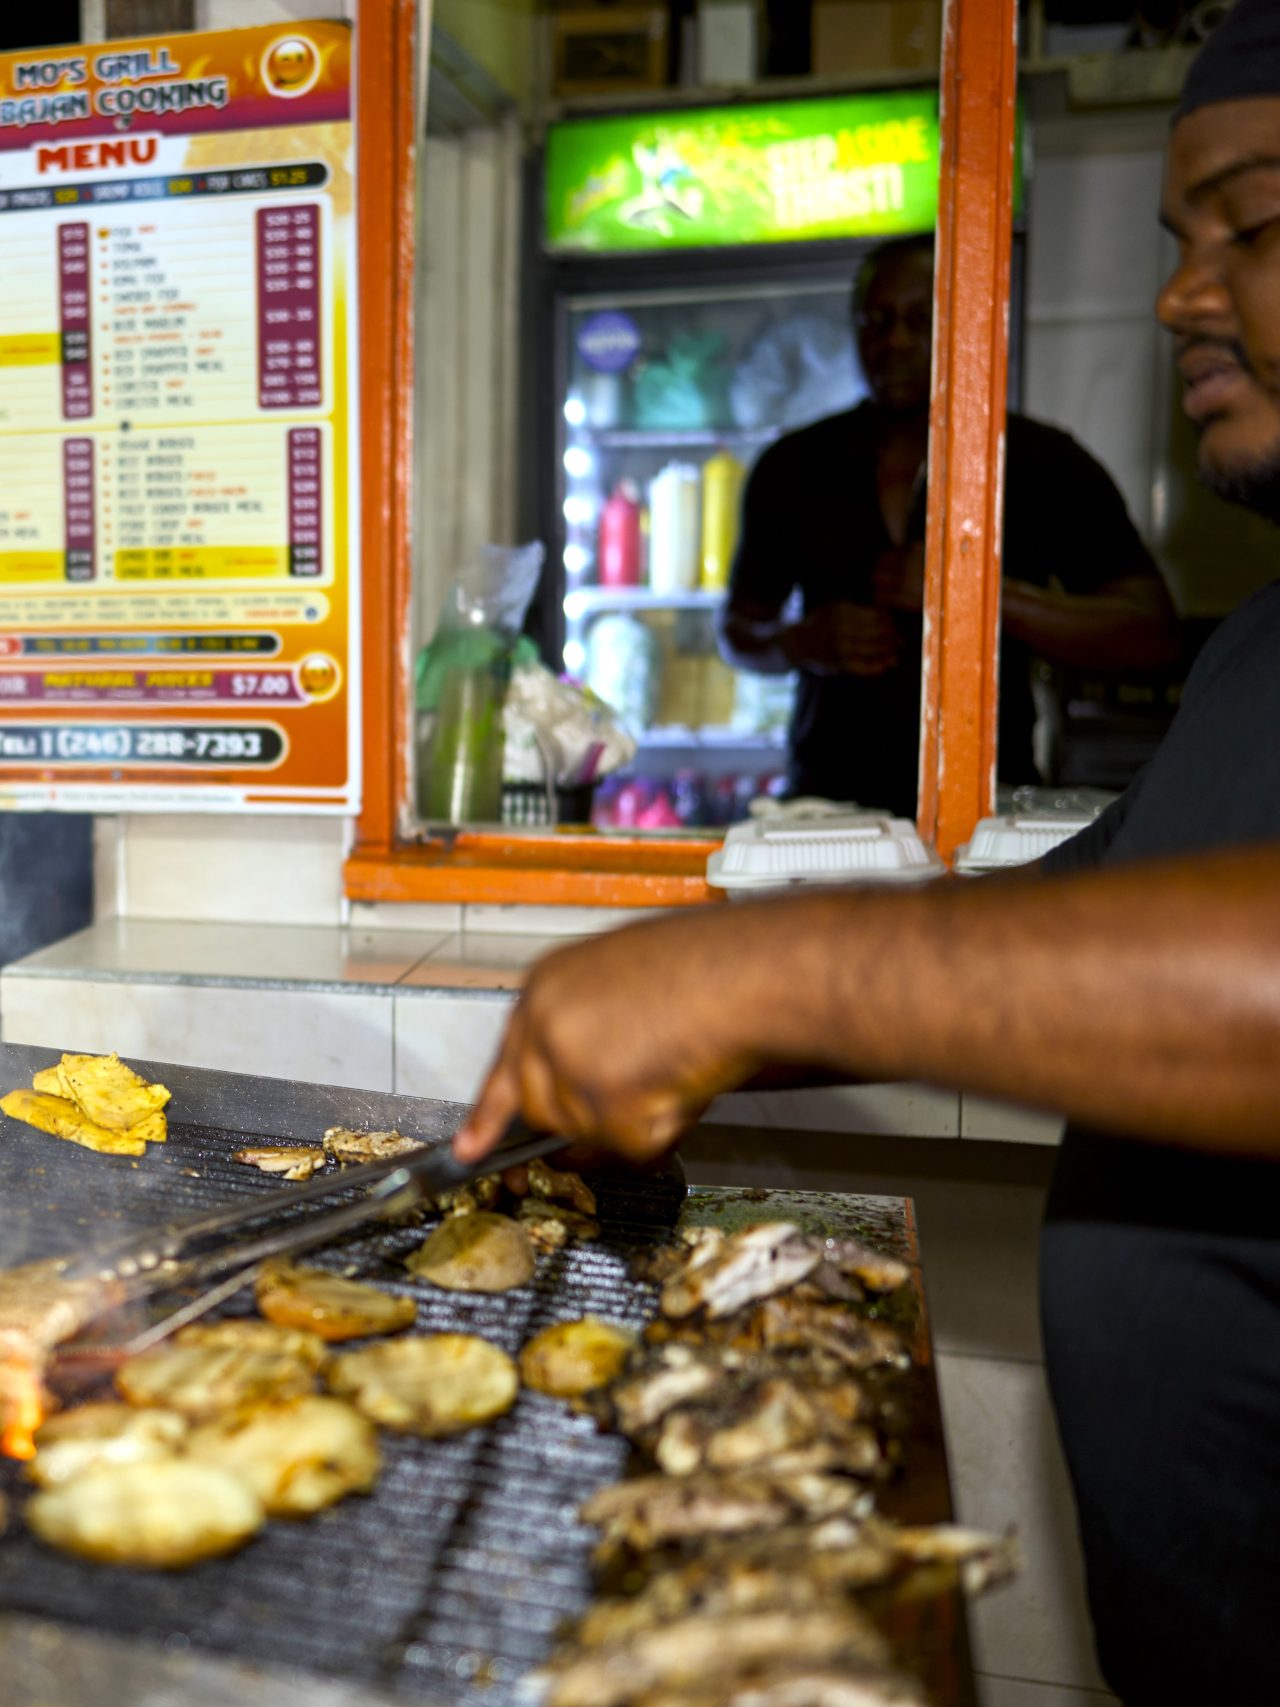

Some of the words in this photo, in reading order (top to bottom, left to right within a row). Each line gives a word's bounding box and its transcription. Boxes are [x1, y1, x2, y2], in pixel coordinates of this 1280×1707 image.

[15, 59, 86, 88] MO'S
[95, 50, 179, 80] GRILL
[0, 94, 89, 126] BAJAN
[97, 80, 228, 115] COOKING
[37, 138, 157, 173] MENU
[837, 117, 930, 171] ASIDE
[231, 674, 290, 696] $7.00
[40, 731, 54, 757] 1
[137, 731, 262, 758] 288-7393
